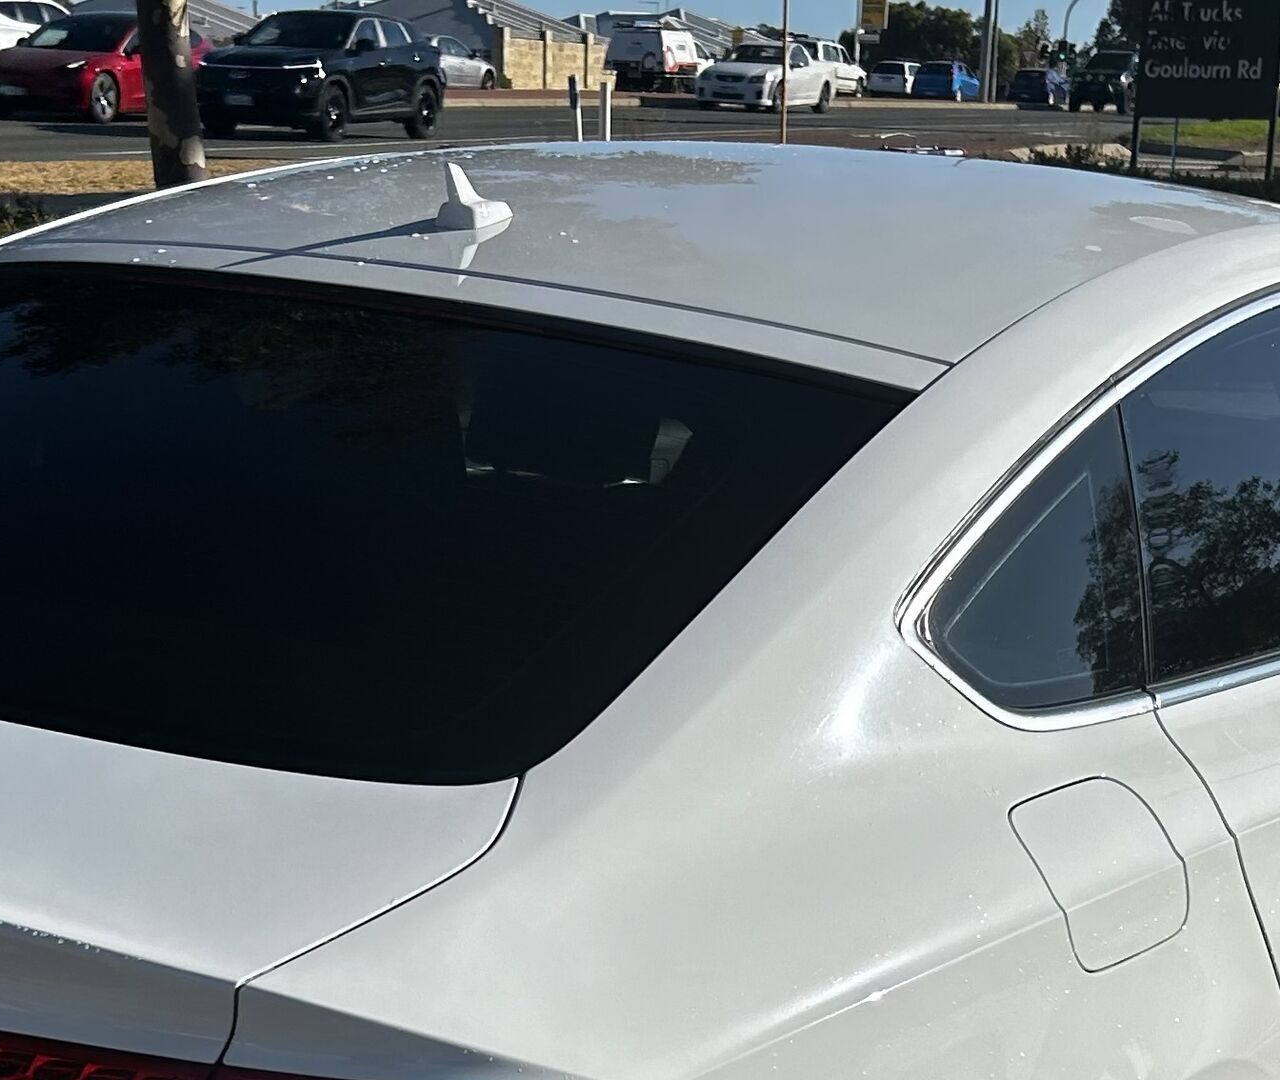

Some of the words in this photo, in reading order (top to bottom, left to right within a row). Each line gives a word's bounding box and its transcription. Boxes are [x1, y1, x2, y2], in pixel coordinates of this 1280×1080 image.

[1148, 0, 1174, 21] Al
[1182, 0, 1243, 21] Tucks
[1144, 56, 1231, 79] Goulburn
[1237, 56, 1263, 79] Rd
